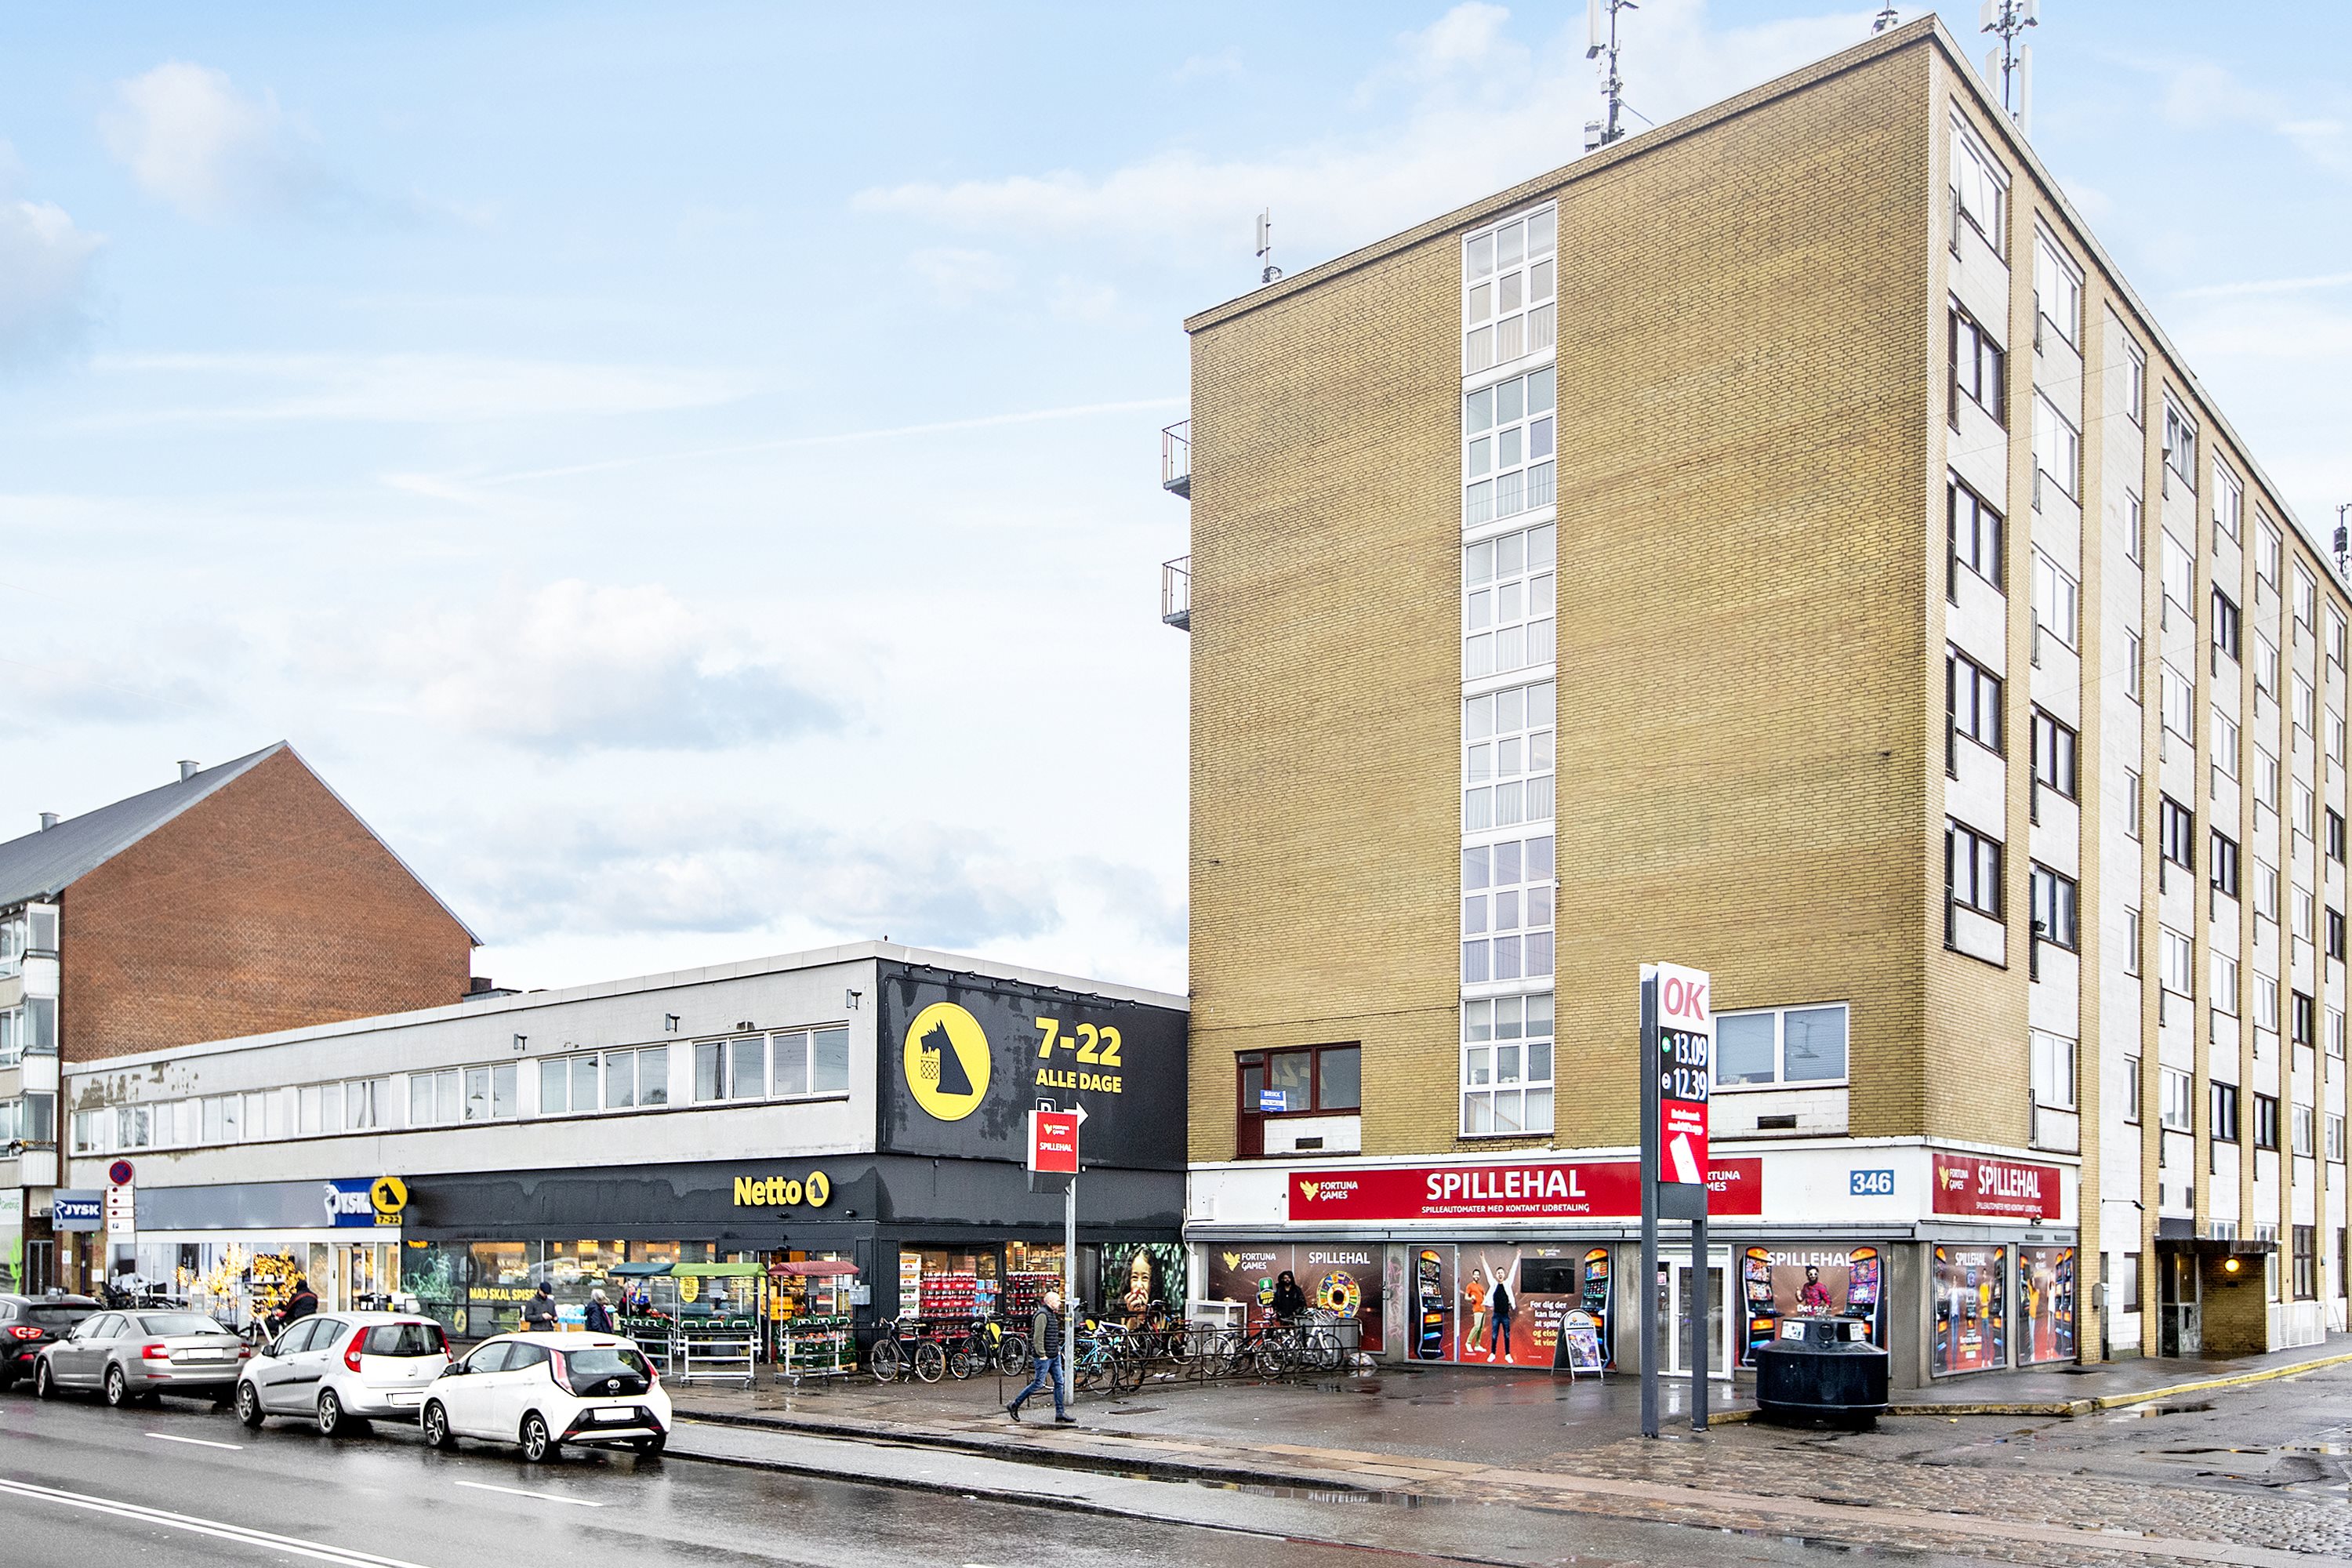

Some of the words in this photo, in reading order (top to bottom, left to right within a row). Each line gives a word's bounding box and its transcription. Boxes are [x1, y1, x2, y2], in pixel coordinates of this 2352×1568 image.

[1664, 978, 1706, 1021] OK
[1035, 1017, 1122, 1067] 7-22
[1673, 1032, 1707, 1066] 13.09
[1035, 1069, 1076, 1089] ALLE
[1079, 1074, 1122, 1094] DAGE
[1673, 1067, 1707, 1101] 12.39
[1040, 1142, 1073, 1152] SPILLEHAL
[1708, 1171, 1740, 1181] RTUNA
[1949, 1168, 1969, 1179] FORTUNA
[1320, 1181, 1359, 1190] FORTUNA
[1426, 1170, 1586, 1200] SPILLEHAL
[1707, 1181, 1726, 1192] MES
[1853, 1172, 1892, 1193] 346
[1949, 1179, 1964, 1191] GAMES
[1977, 1164, 2042, 1199] SPILLEHAL
[734, 1176, 802, 1206] Netto
[1320, 1190, 1348, 1201] GAMES
[332, 1190, 373, 1214] JYSK
[1421, 1205, 1486, 1214] SPILLEAUTOMATER
[1542, 1203, 1590, 1213] UDBETALING
[64, 1204, 100, 1215] JYSK
[1241, 1252, 1276, 1261] FORTUNA
[1308, 1252, 1370, 1265] SPILLEHAL
[1766, 1252, 1855, 1267] SPILLEHAL
[1955, 1252, 1986, 1267] SPILLEHAL
[1241, 1261, 1267, 1271] GAMES
[470, 1287, 488, 1300] MAD
[488, 1288, 511, 1301] SKAL
[511, 1288, 538, 1301] SPISE
[1542, 1301, 1554, 1310] dig
[1555, 1301, 1567, 1309] der
[1548, 1310, 1562, 1319] lide
